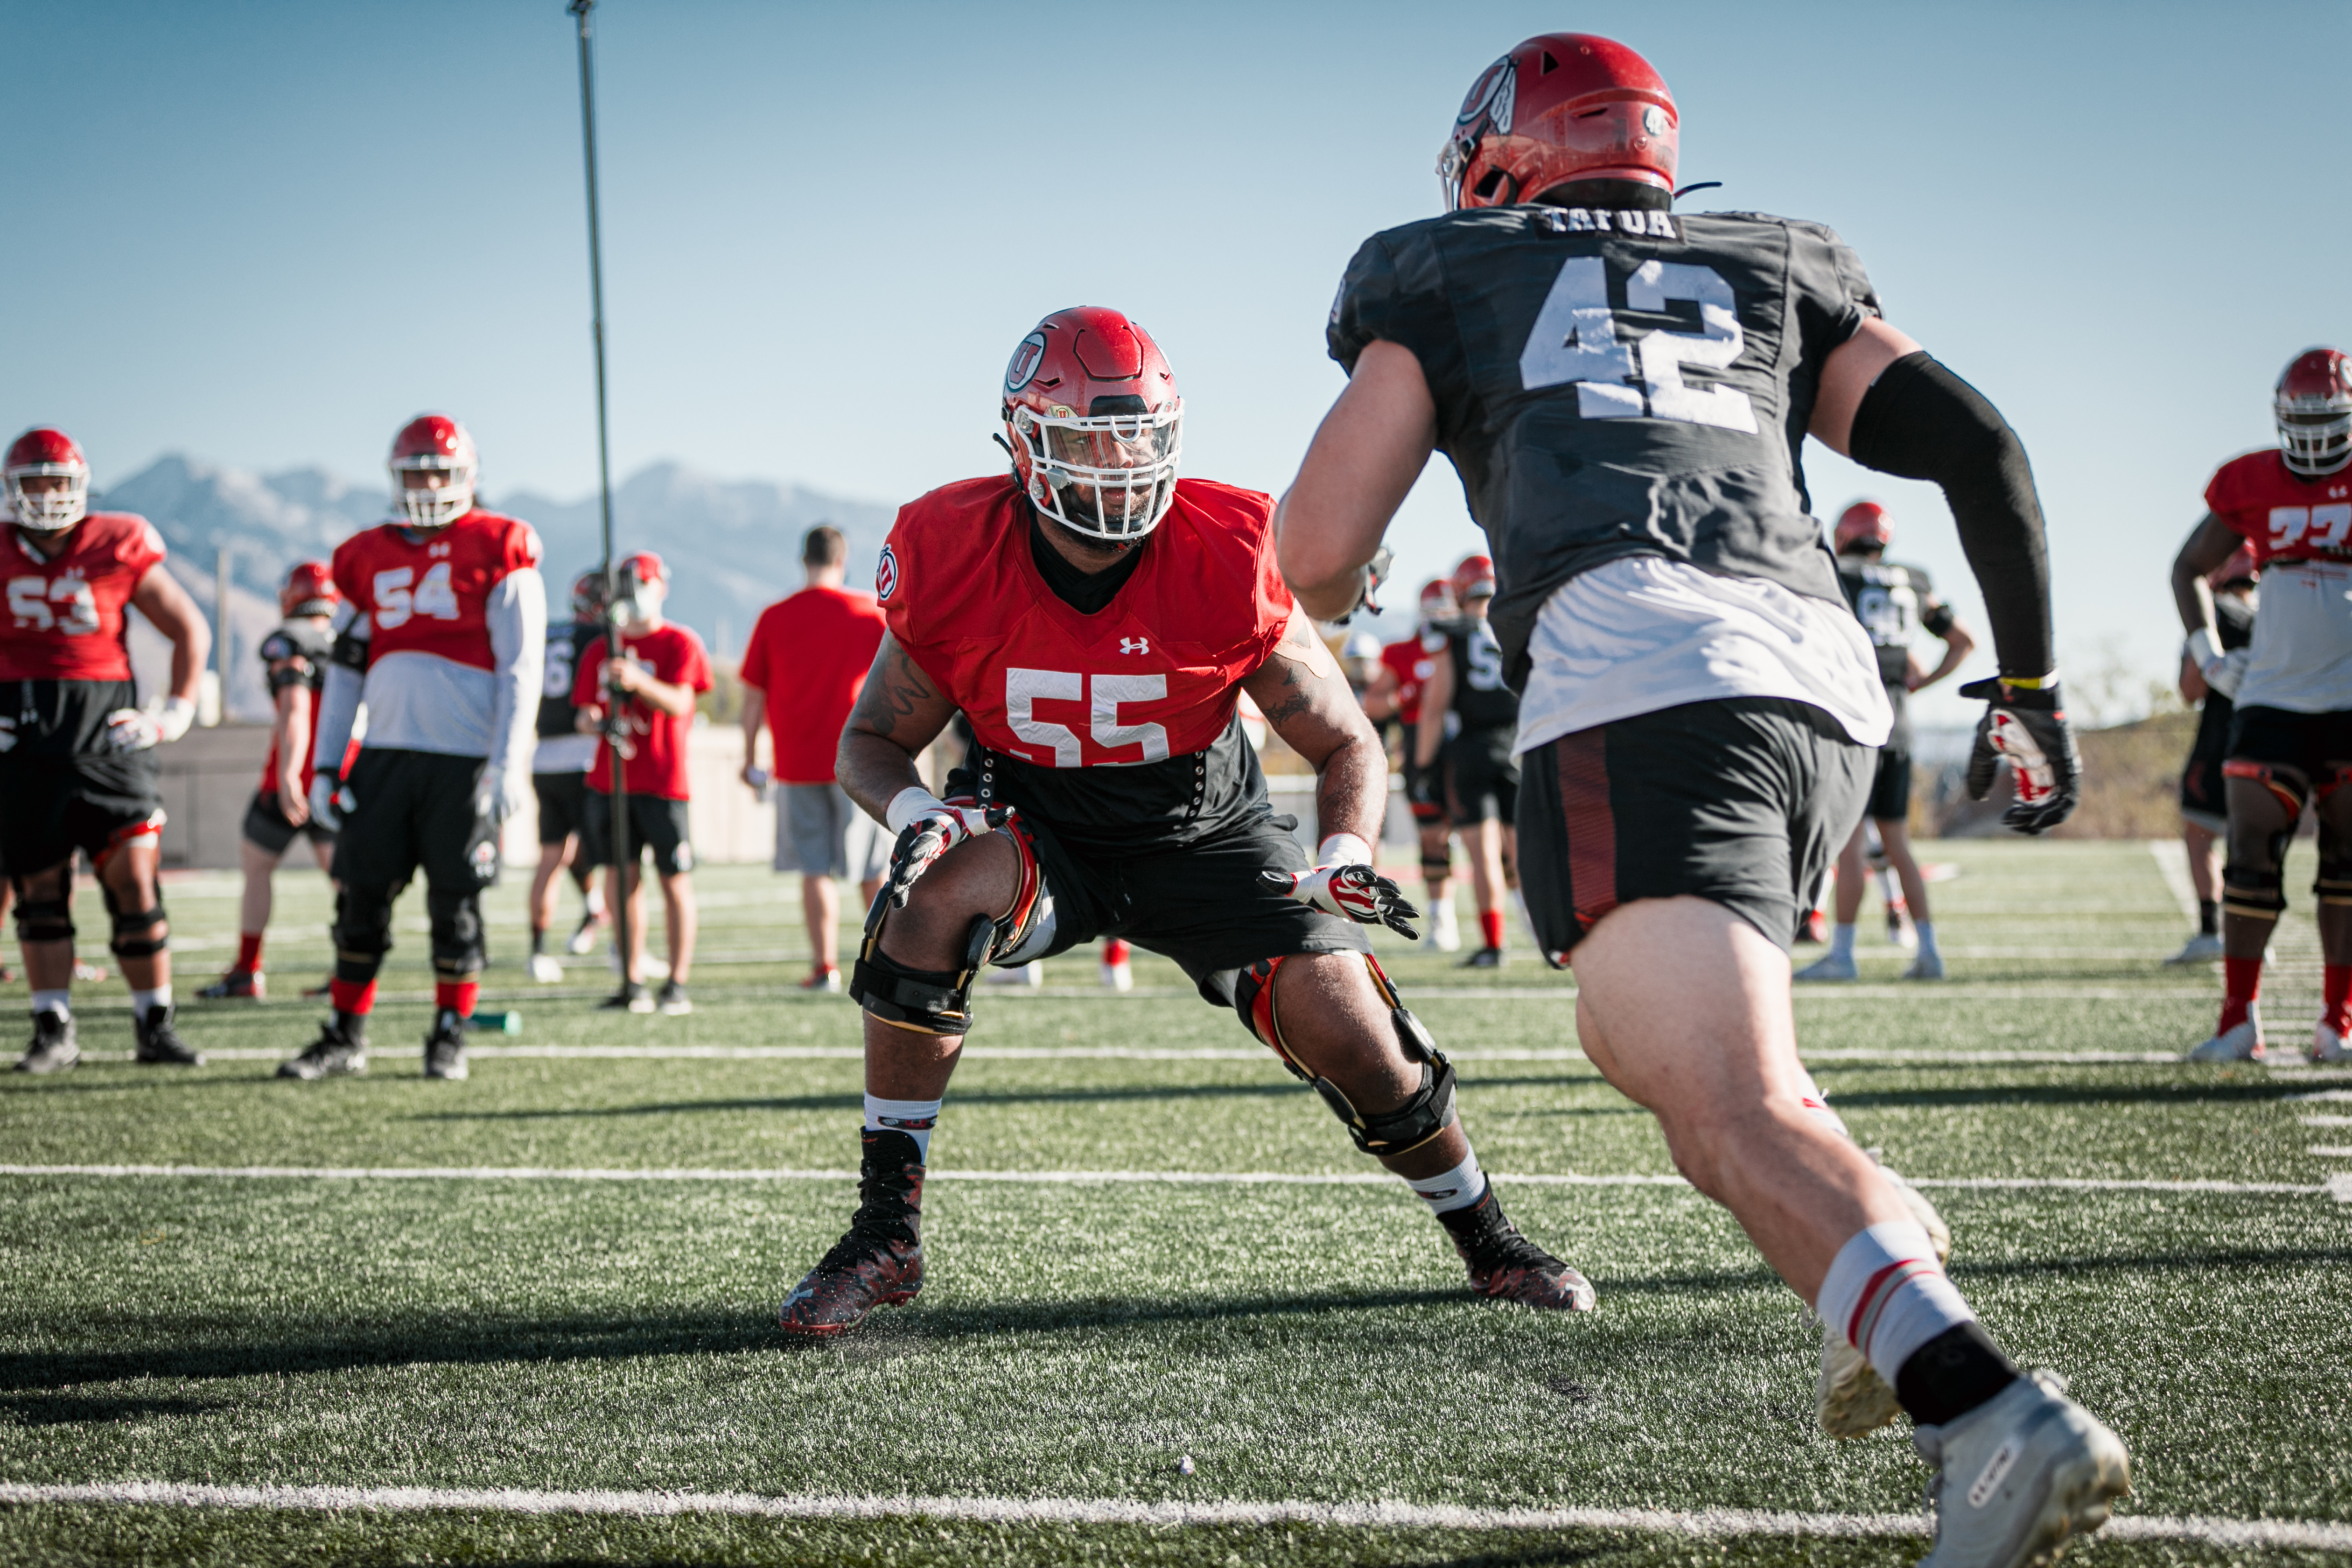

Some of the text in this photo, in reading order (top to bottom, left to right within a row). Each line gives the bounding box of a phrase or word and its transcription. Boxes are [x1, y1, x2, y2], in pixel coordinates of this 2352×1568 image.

[1009, 340, 1042, 385] U
[1519, 256, 1759, 434] 42
[7, 575, 100, 637] 53
[372, 561, 461, 630] 54
[1006, 667, 1169, 767] 55
